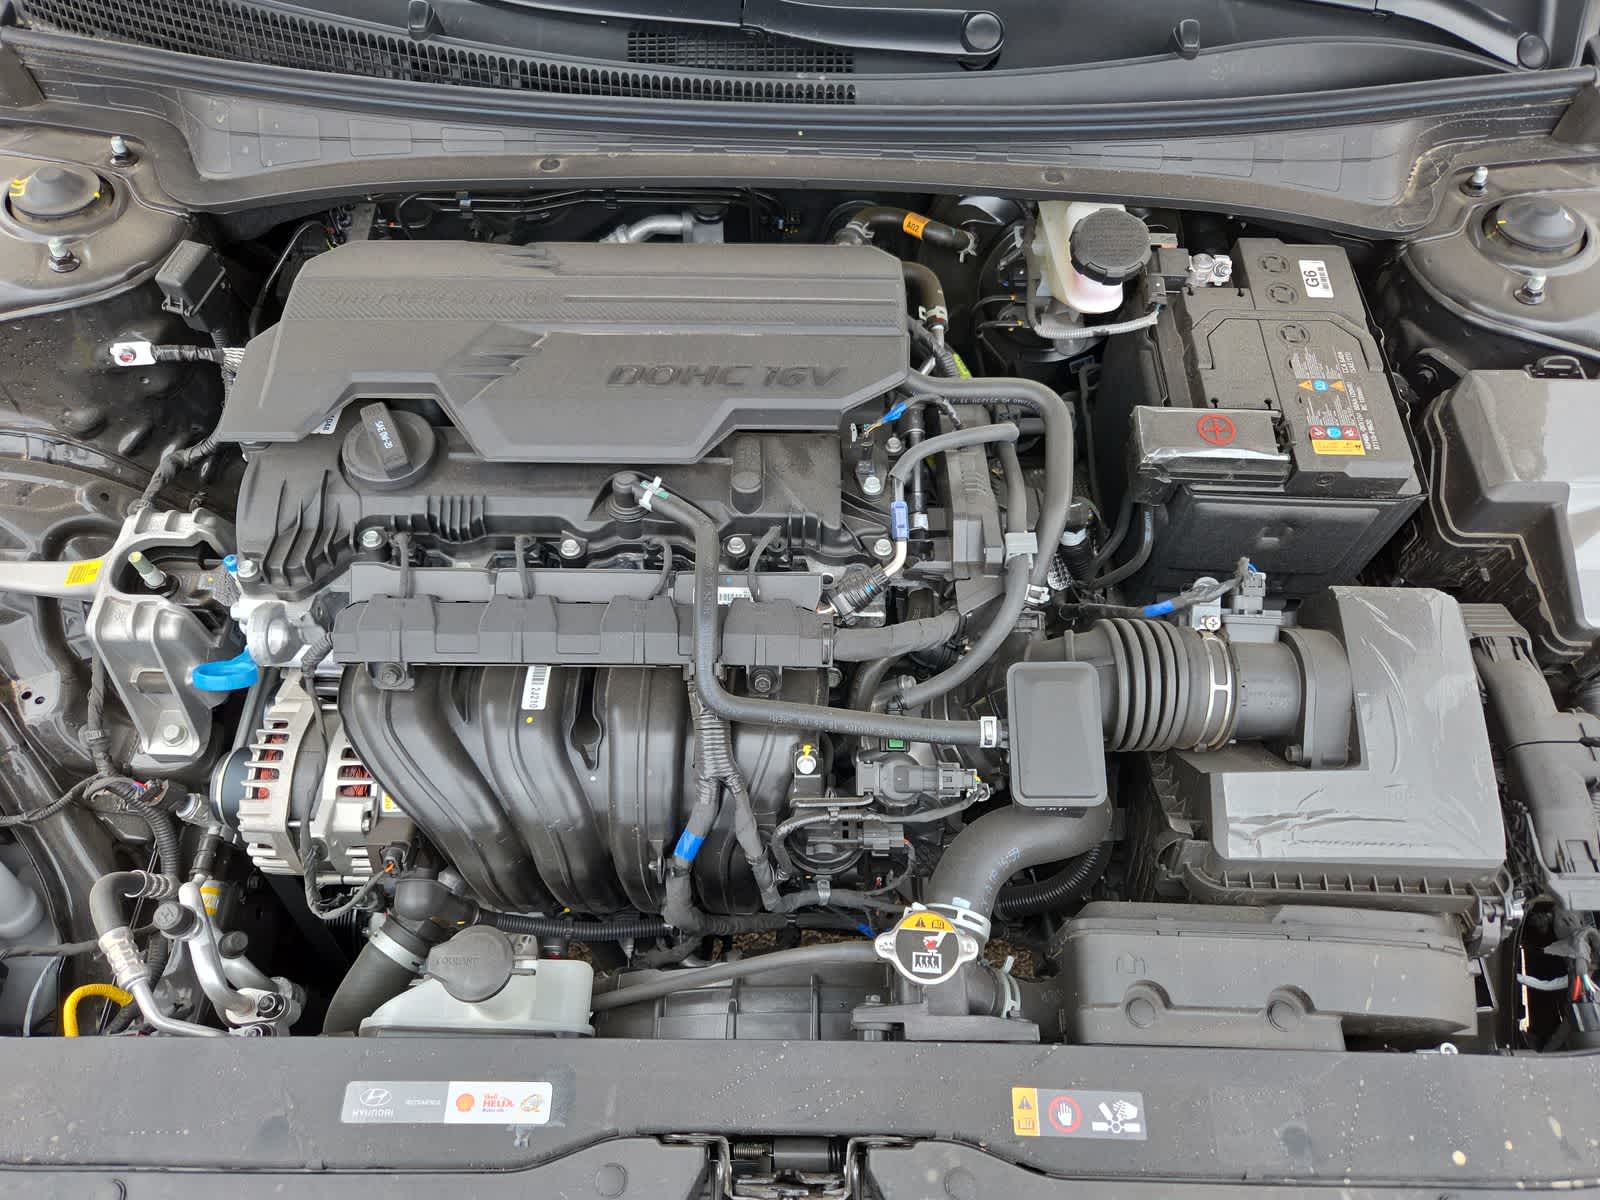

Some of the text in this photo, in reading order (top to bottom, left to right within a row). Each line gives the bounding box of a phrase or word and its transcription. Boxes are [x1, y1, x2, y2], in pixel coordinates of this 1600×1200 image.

[1303, 270, 1319, 288] G6
[606, 364, 849, 386] DOHC 16V
[482, 1099, 514, 1108] HELIX
[352, 1108, 394, 1118] HYUNDAI
